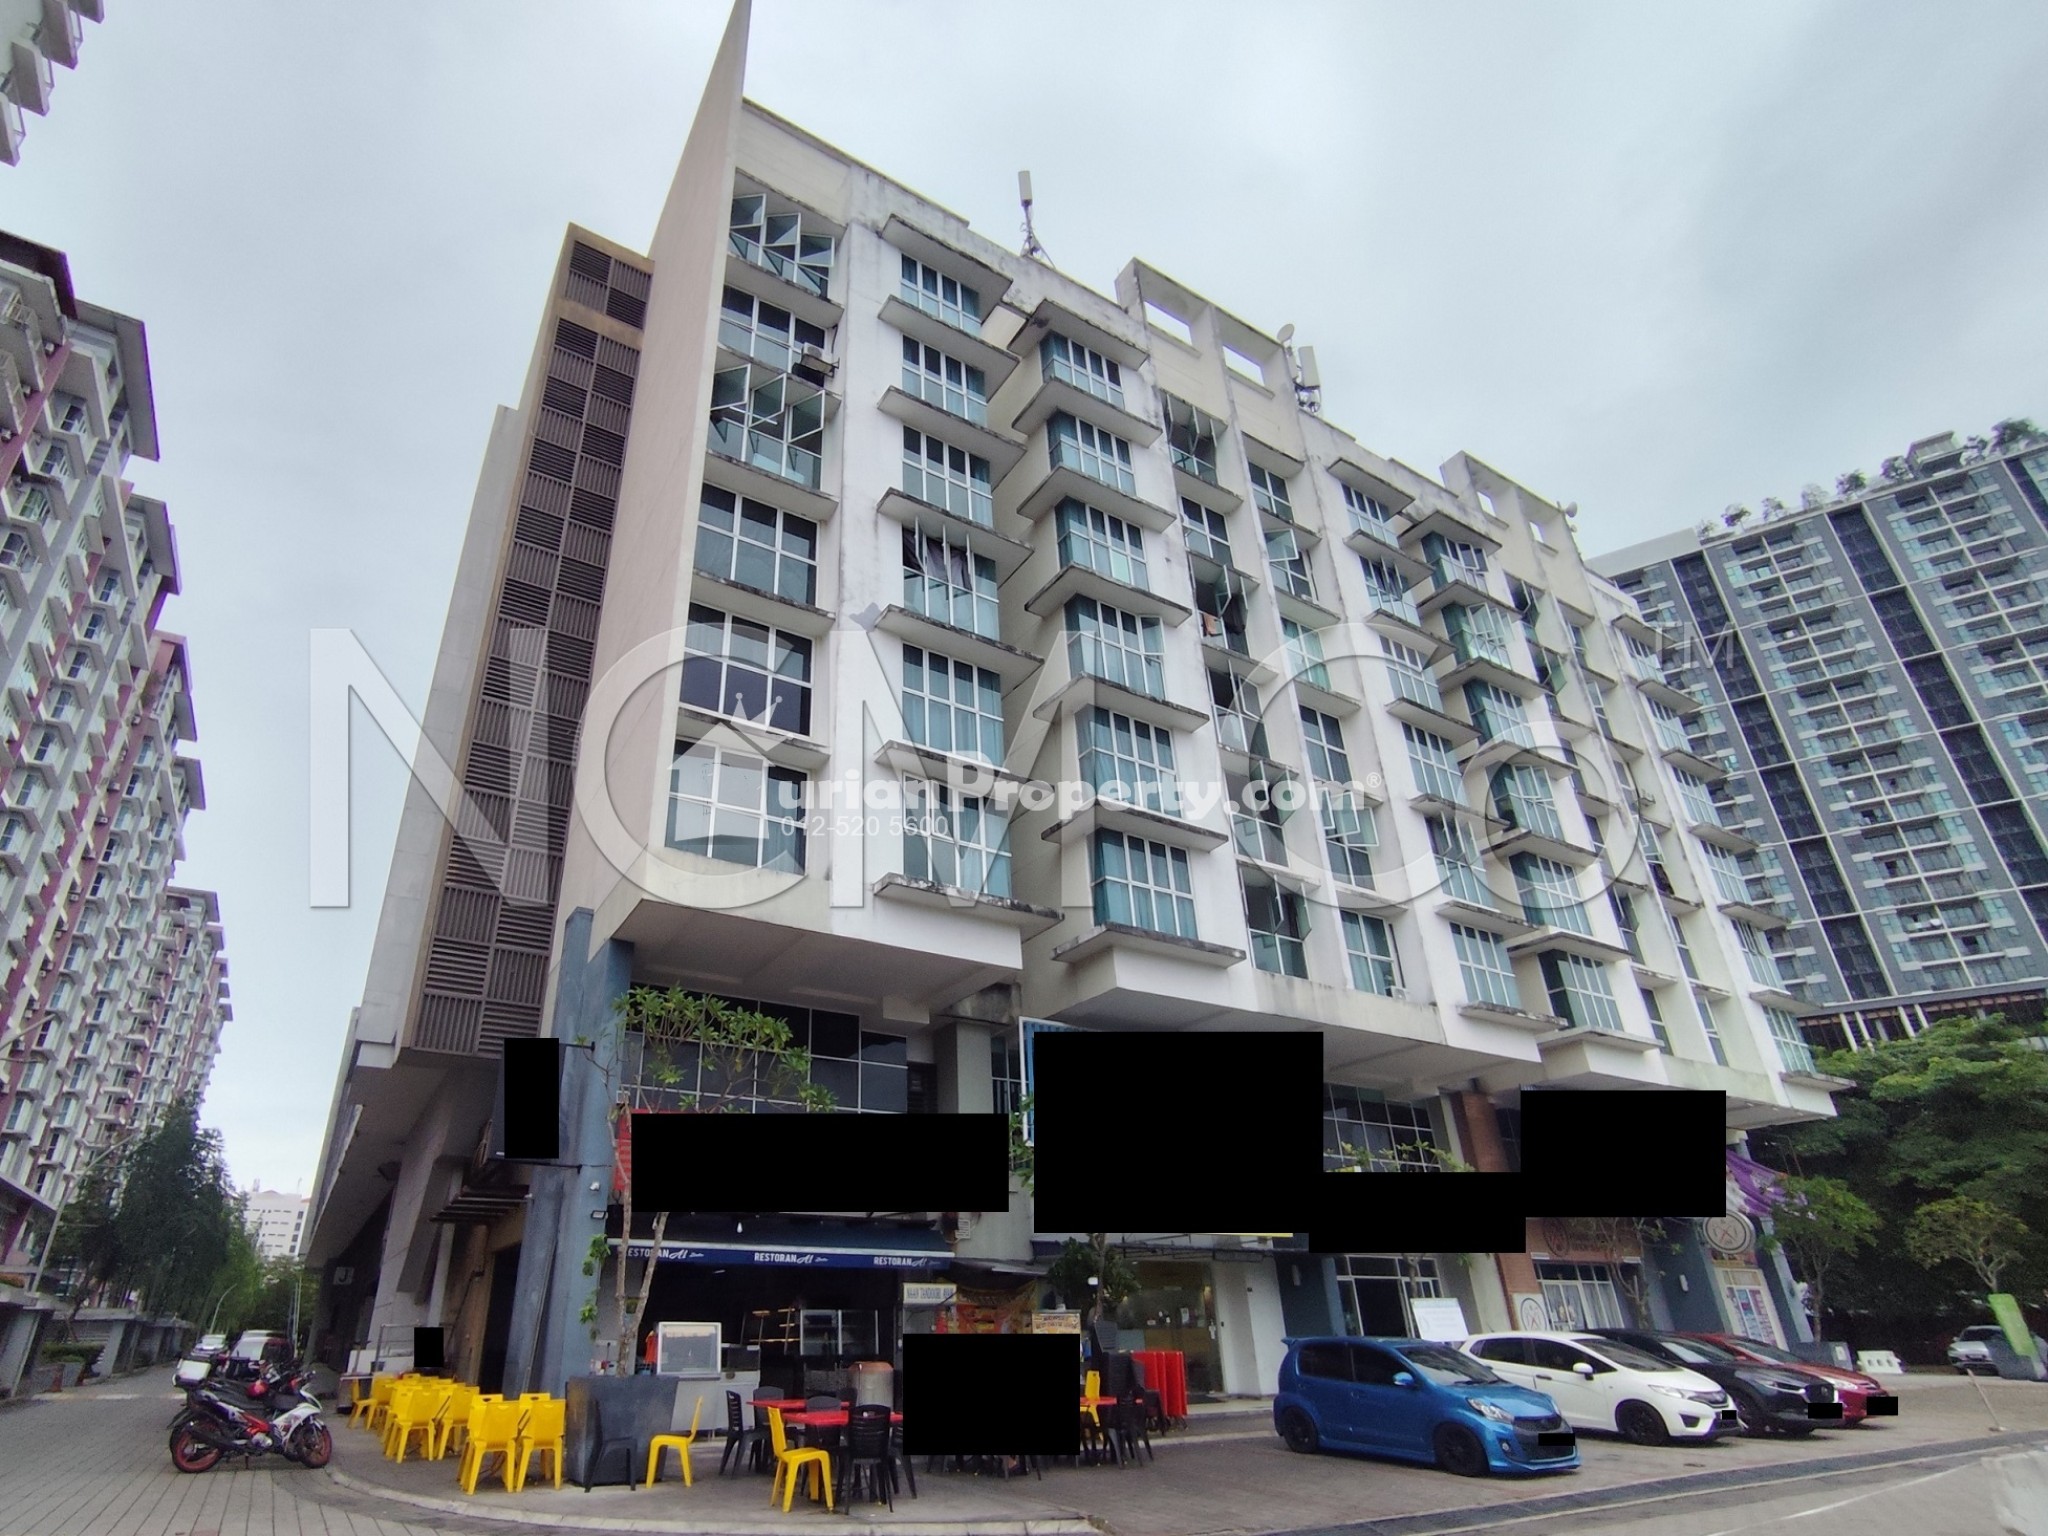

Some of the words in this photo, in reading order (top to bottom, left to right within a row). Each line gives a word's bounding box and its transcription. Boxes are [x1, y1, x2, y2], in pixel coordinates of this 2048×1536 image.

[625, 1247, 669, 1259] ESTOAN
[754, 1252, 797, 1263] RESTORAN
[873, 1256, 912, 1267] RESTORAN
[338, 1268, 349, 1283] J
